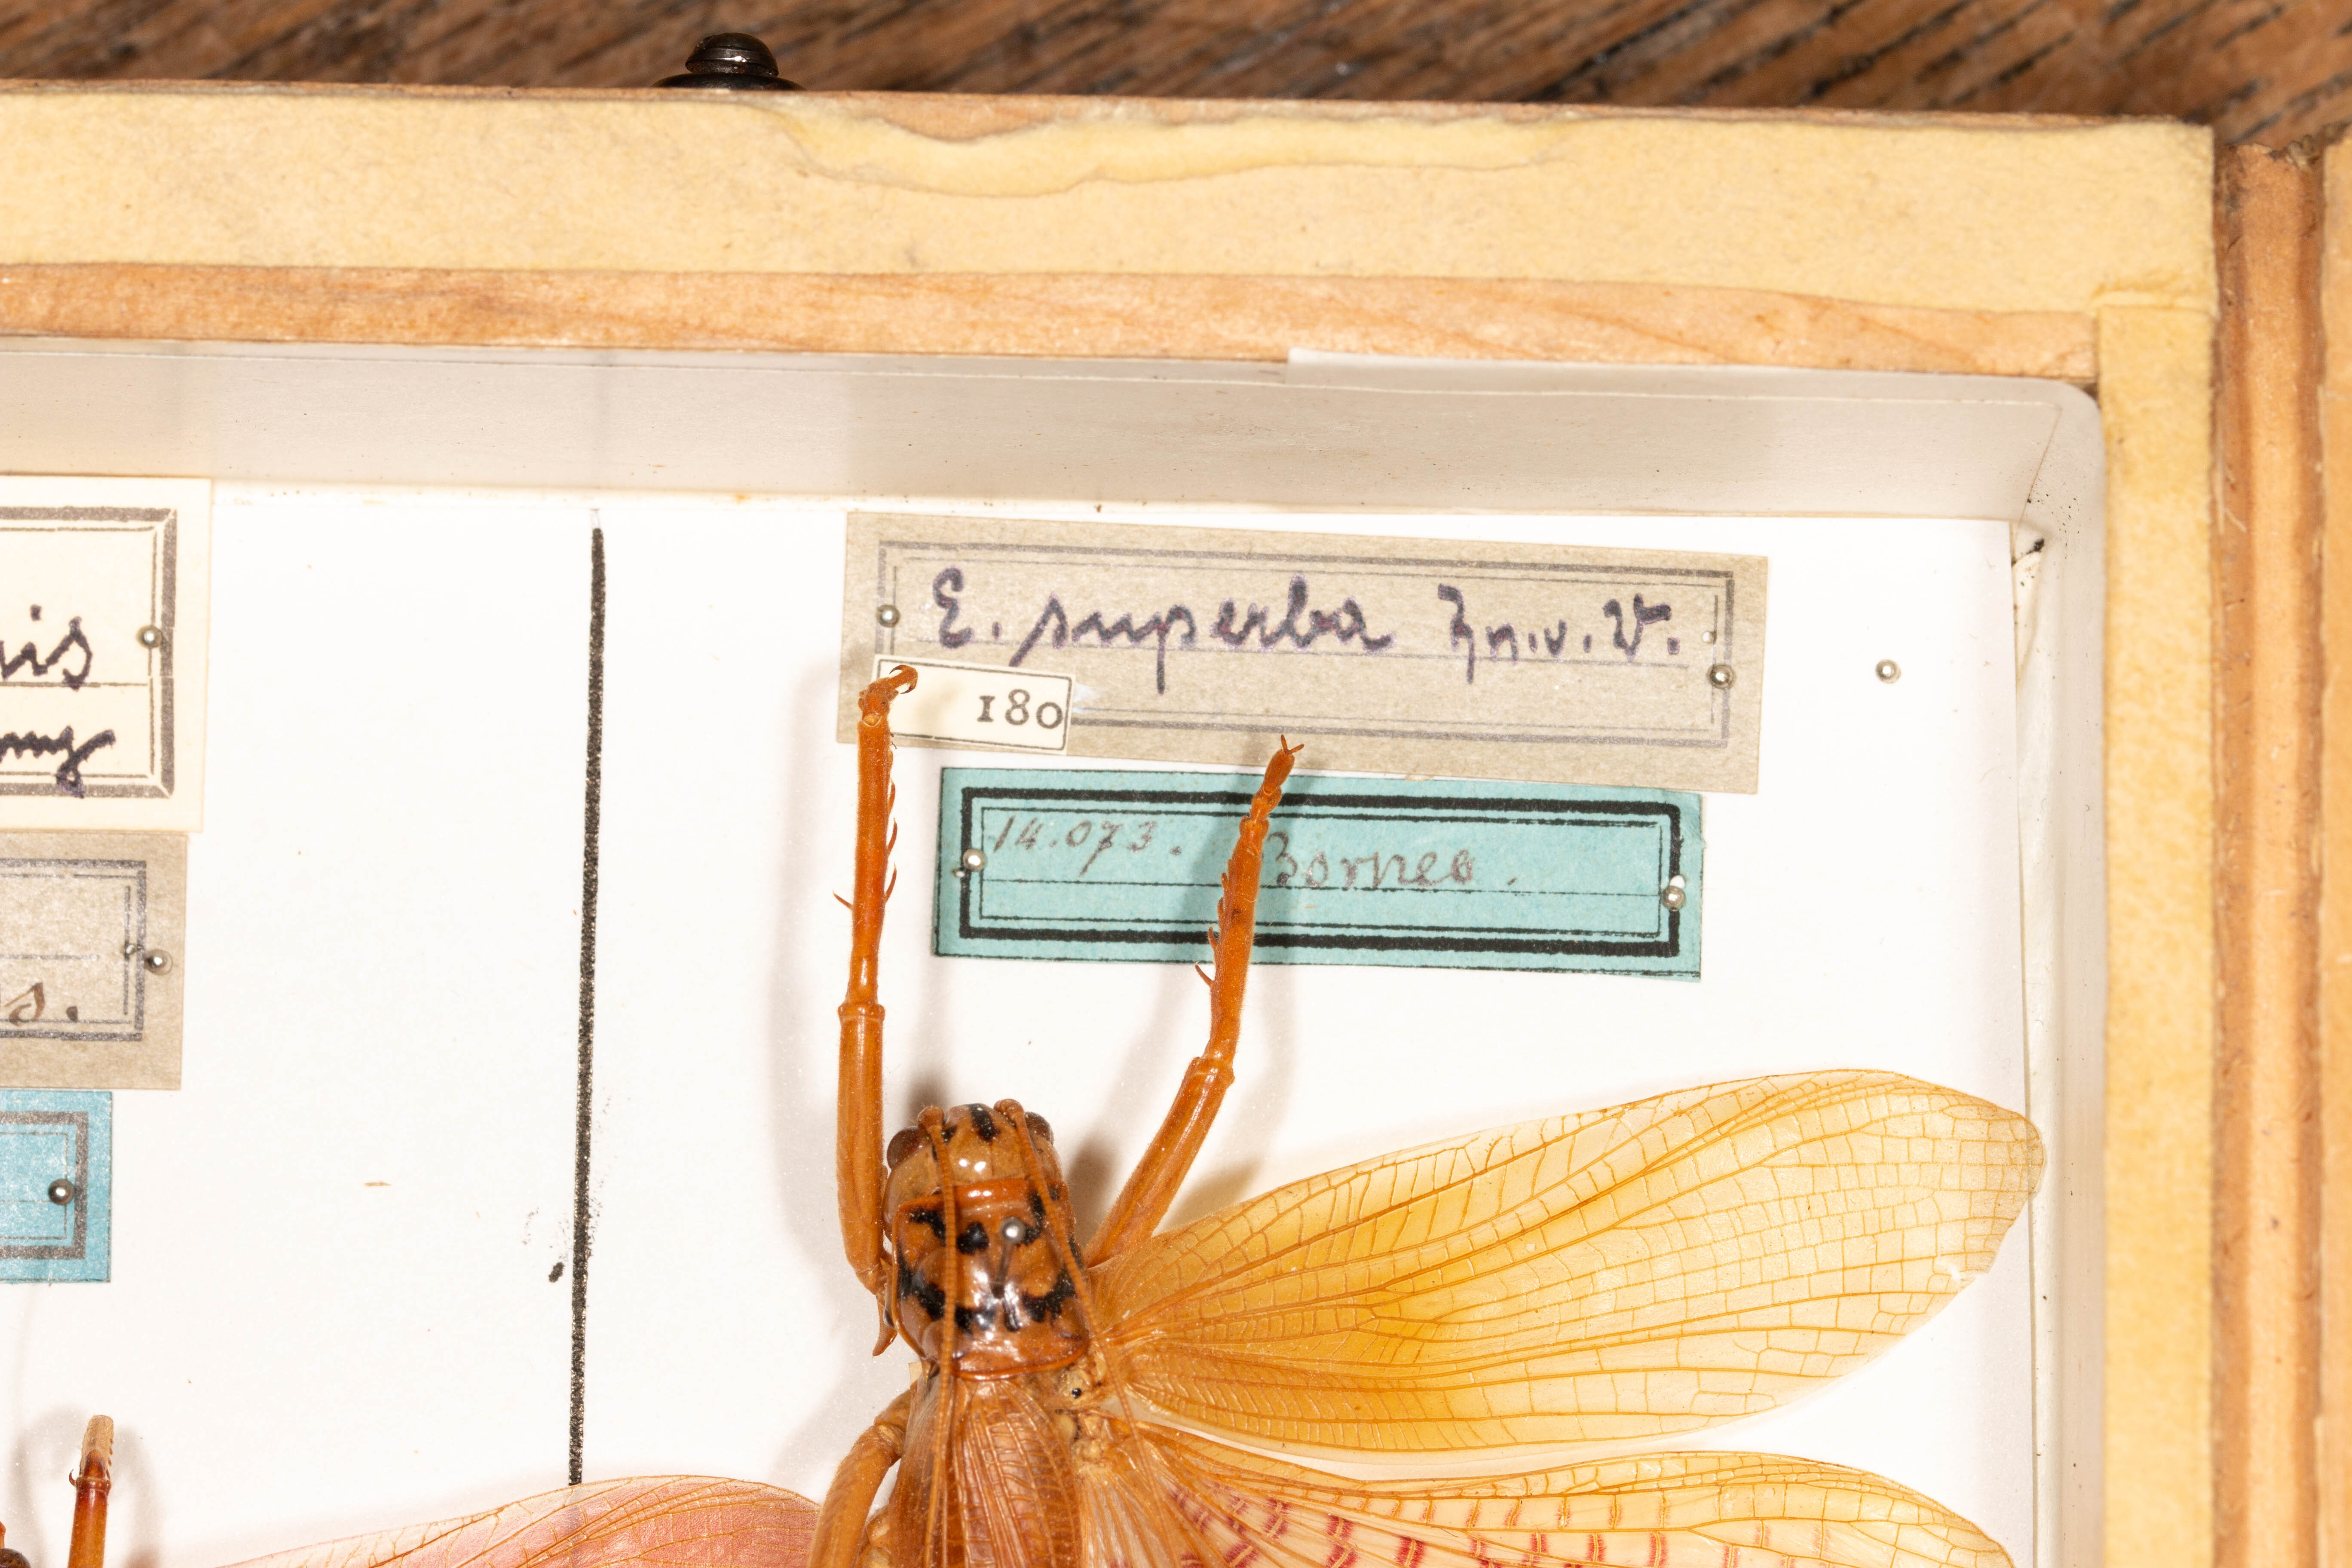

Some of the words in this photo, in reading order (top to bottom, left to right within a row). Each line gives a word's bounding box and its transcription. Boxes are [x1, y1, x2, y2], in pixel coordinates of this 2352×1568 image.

[0, 604, 92, 692] is
[932, 565, 1001, 649] E.
[1008, 573, 1396, 696] superba
[977, 689, 1064, 729] 180
